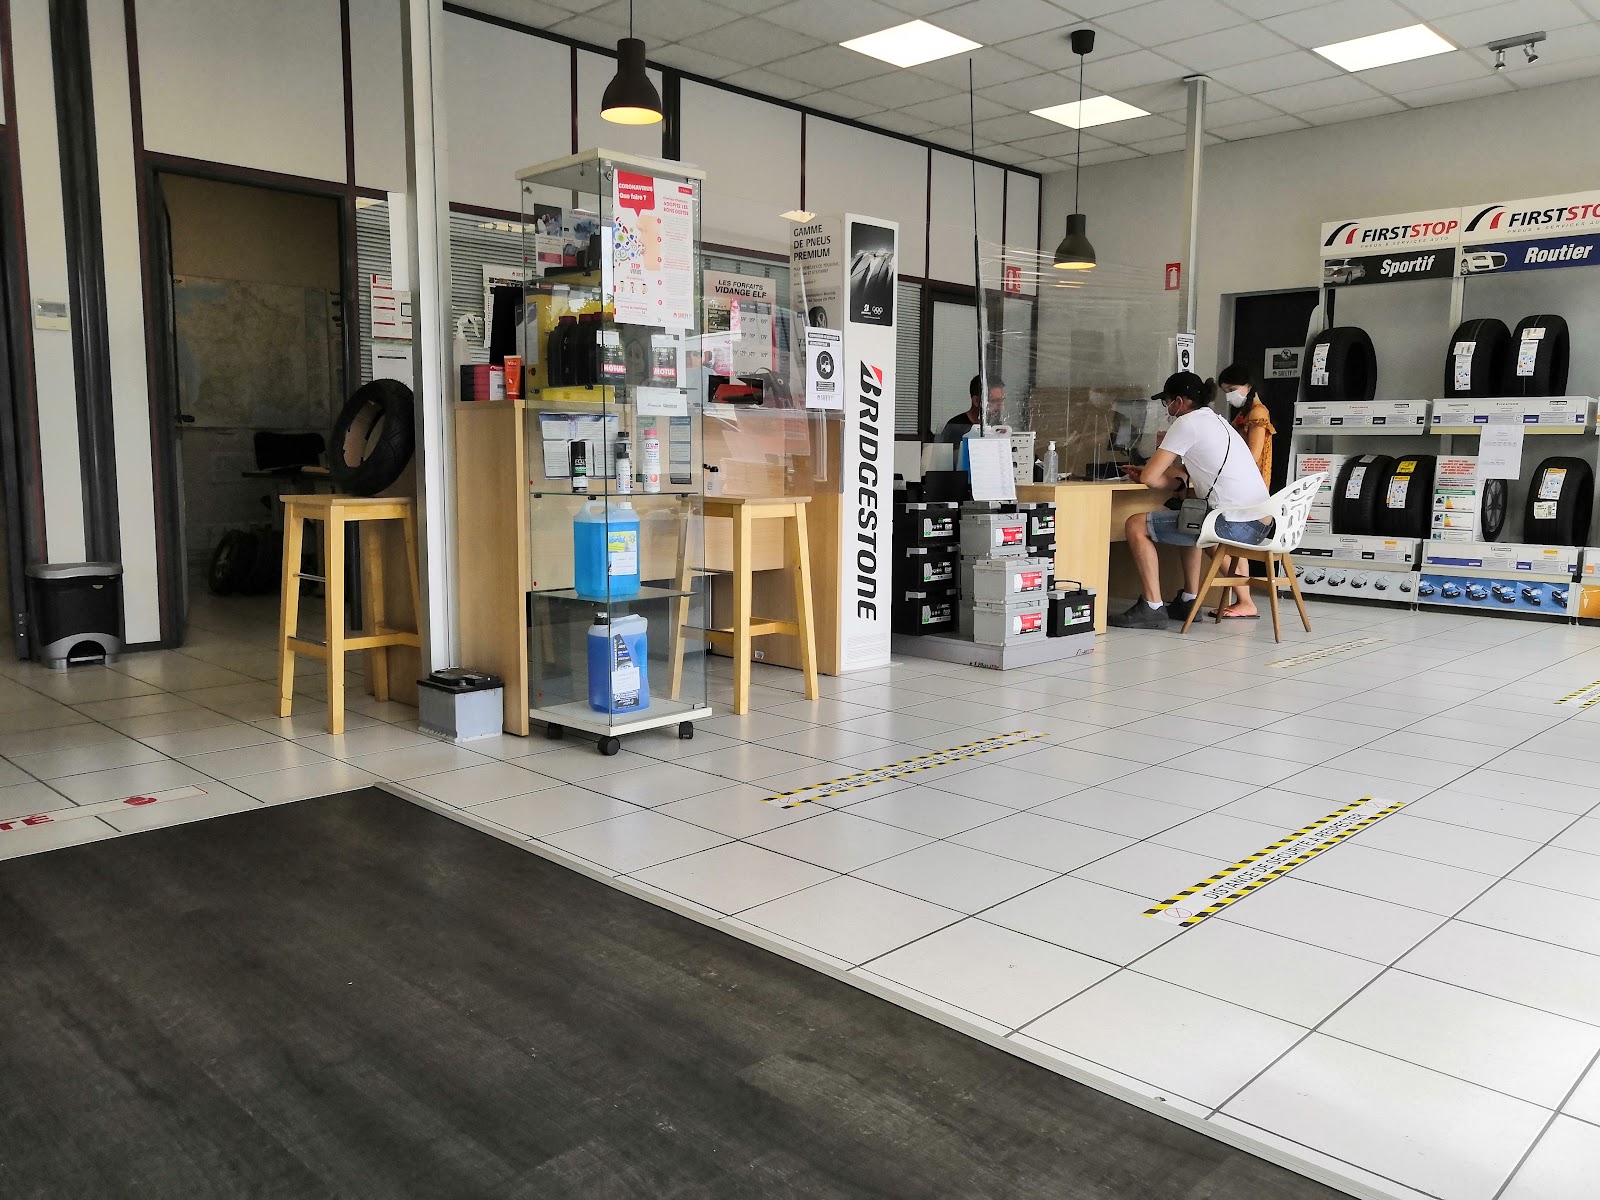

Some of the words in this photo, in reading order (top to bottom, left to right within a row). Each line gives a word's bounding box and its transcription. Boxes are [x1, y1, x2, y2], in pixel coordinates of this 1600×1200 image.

[618, 183, 653, 192] CORONAVIRUS
[793, 225, 823, 237] GAMME
[1361, 220, 1458, 243] FIRSTSTOP
[1545, 222, 1585, 230] SERVICES
[793, 239, 804, 249] DE
[805, 235, 831, 248] PNEUS
[793, 248, 830, 261] PREMIUM
[1524, 244, 1593, 264] Routier
[1380, 255, 1435, 277] Sportif
[718, 279, 732, 287] LES
[732, 281, 763, 291] FORFAITS
[715, 286, 751, 297] VIDANGE
[603, 364, 624, 373] MOTUL
[653, 368, 675, 376] MOTUL
[857, 360, 883, 621] BRIDGESTONE
[1203, 871, 1259, 900] DISTANCE
[1254, 863, 1273, 874] DE
[1269, 839, 1311, 865] SÉCURITÉ
[1315, 812, 1367, 839] RESPECTER
